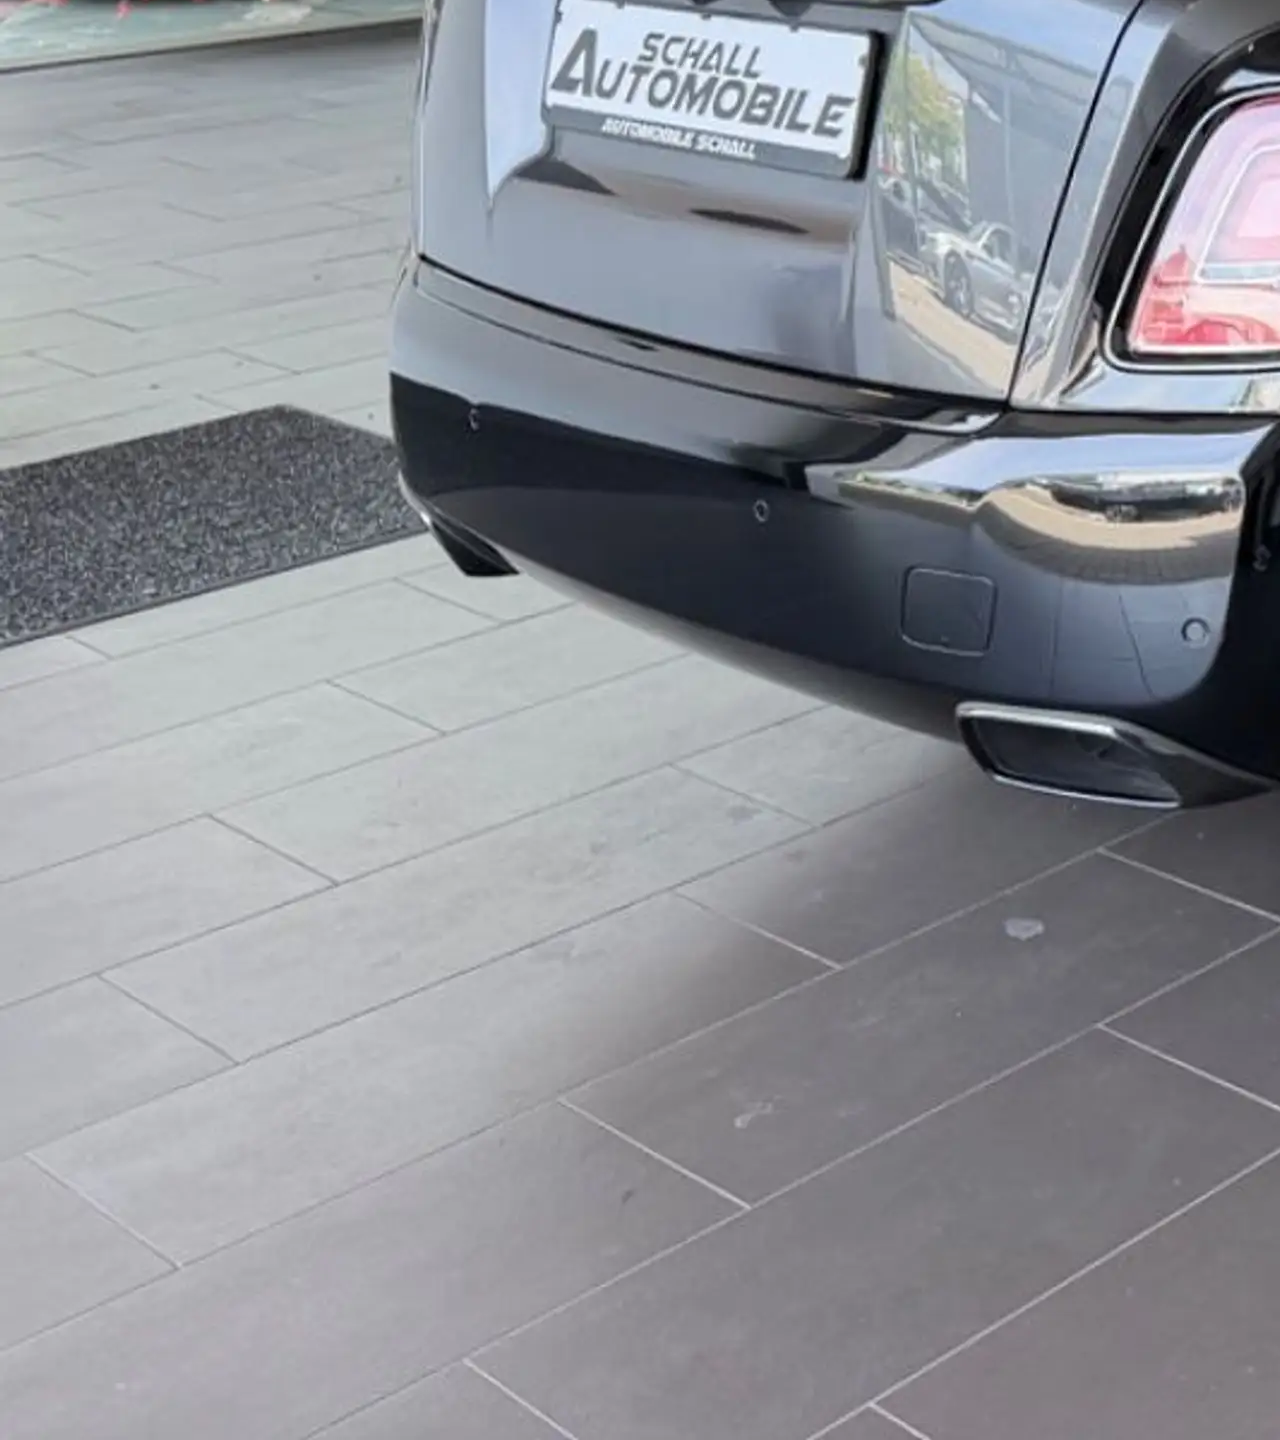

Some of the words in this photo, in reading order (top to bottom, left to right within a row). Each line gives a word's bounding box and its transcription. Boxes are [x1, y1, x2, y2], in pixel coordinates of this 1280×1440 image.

[637, 33, 761, 79] SCHALL
[550, 28, 856, 139] AUTOMOBILE
[602, 117, 692, 150] AUTOMOBILE
[694, 134, 757, 160] SCHALL
